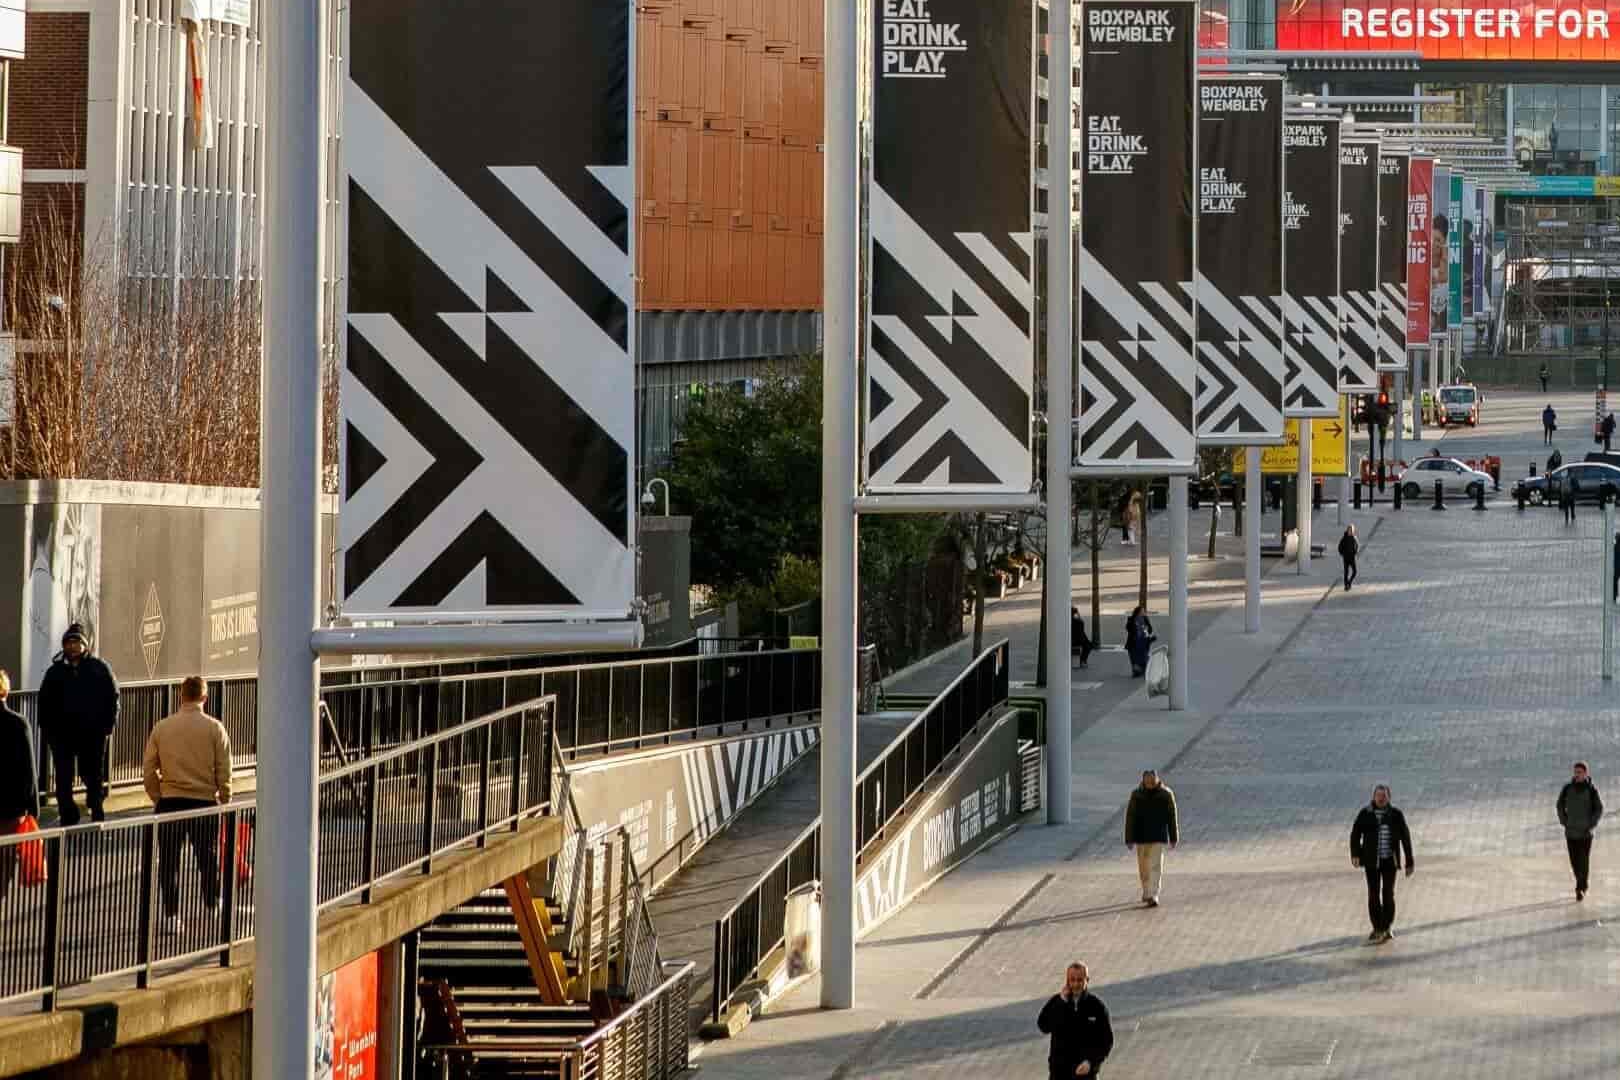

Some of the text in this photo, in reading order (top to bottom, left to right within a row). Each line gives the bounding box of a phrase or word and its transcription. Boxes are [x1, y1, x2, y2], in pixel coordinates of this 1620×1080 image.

[1088, 9, 1170, 26] BOXPARK
[1341, 8, 1521, 39] REGISTER
[1534, 9, 1610, 40] FOR
[883, 23, 968, 46] DRINK.
[1089, 26, 1176, 42] WEMBLEY
[883, 51, 946, 73] PLAY.
[1201, 86, 1263, 98] BOXPARK
[1201, 99, 1268, 111] WEMBLEY
[1088, 116, 1122, 132] EAT.
[1088, 135, 1148, 151] DRINK.
[1284, 136, 1328, 146] EMBLEY
[1088, 155, 1133, 171] PLAY.
[1201, 168, 1226, 180] EAT.
[1201, 183, 1246, 195] DRINK.
[1201, 199, 1235, 210] PLAY.
[923, 804, 956, 873] BOXPARK
